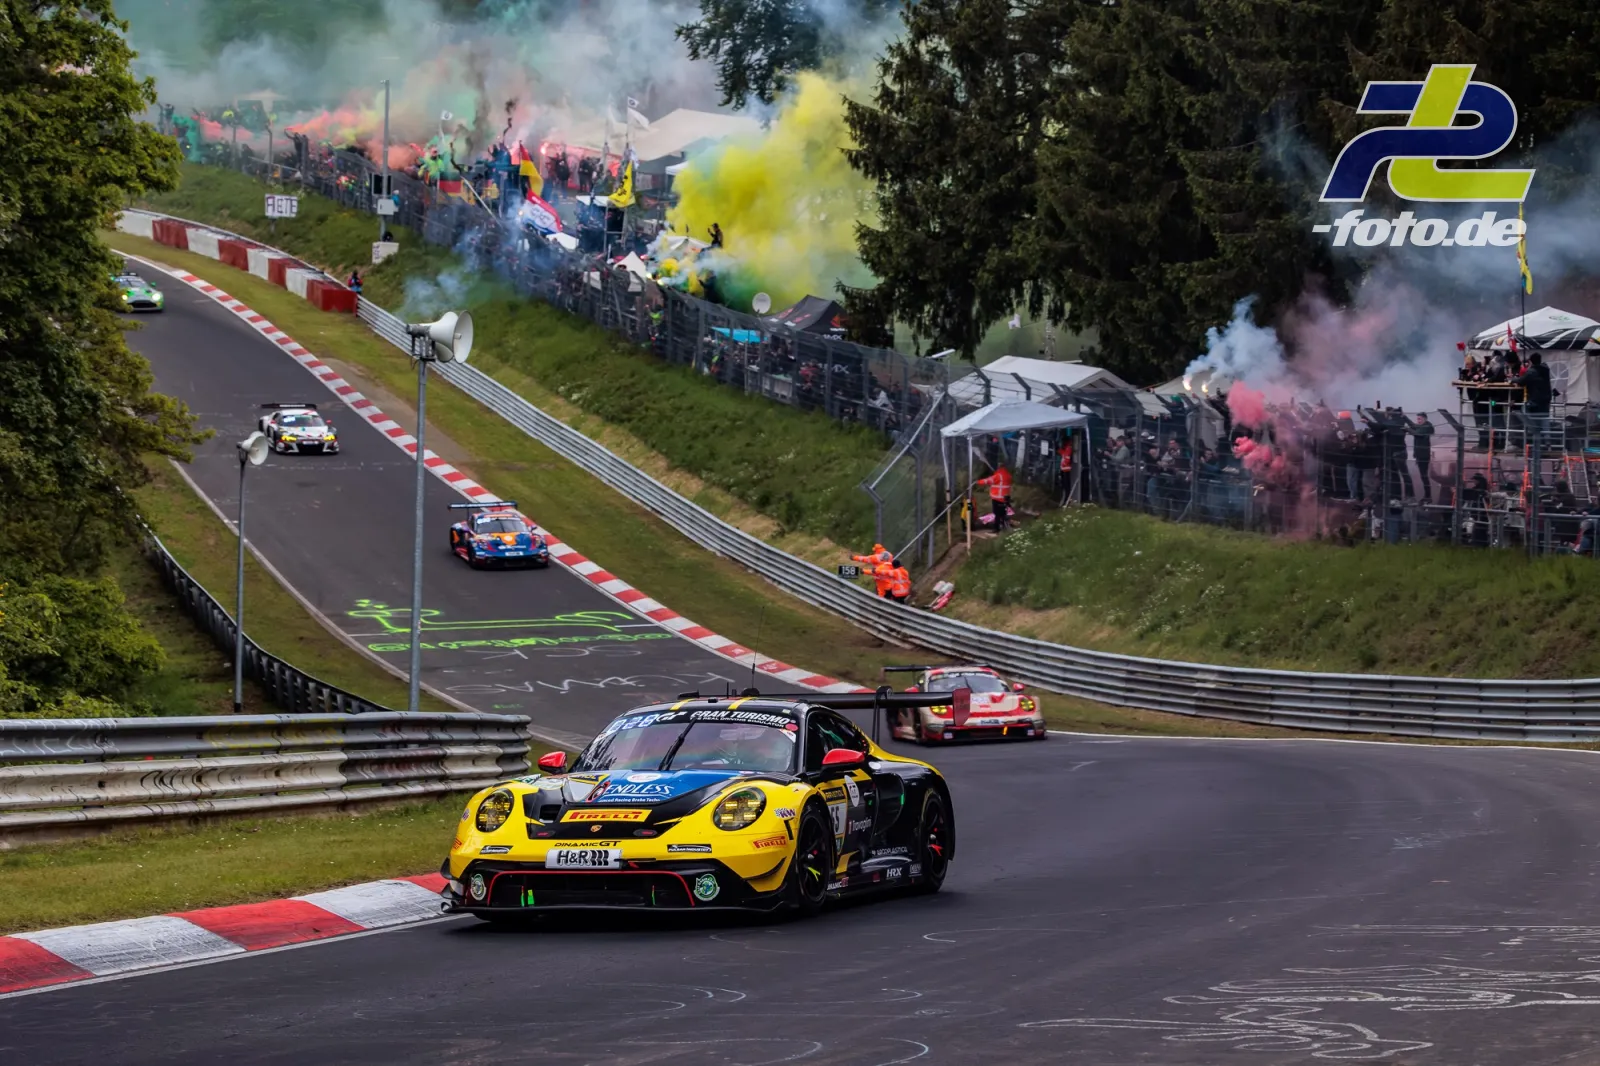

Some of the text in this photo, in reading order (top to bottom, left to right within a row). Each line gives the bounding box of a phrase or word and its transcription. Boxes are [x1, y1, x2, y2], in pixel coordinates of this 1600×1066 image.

[841, 566, 856, 575] 158
[691, 710, 730, 718] GRAN
[602, 783, 674, 795] ENDLESS
[569, 811, 642, 820] PIRELLI
[753, 836, 787, 849] PIRELLI
[886, 867, 902, 878] HRX
